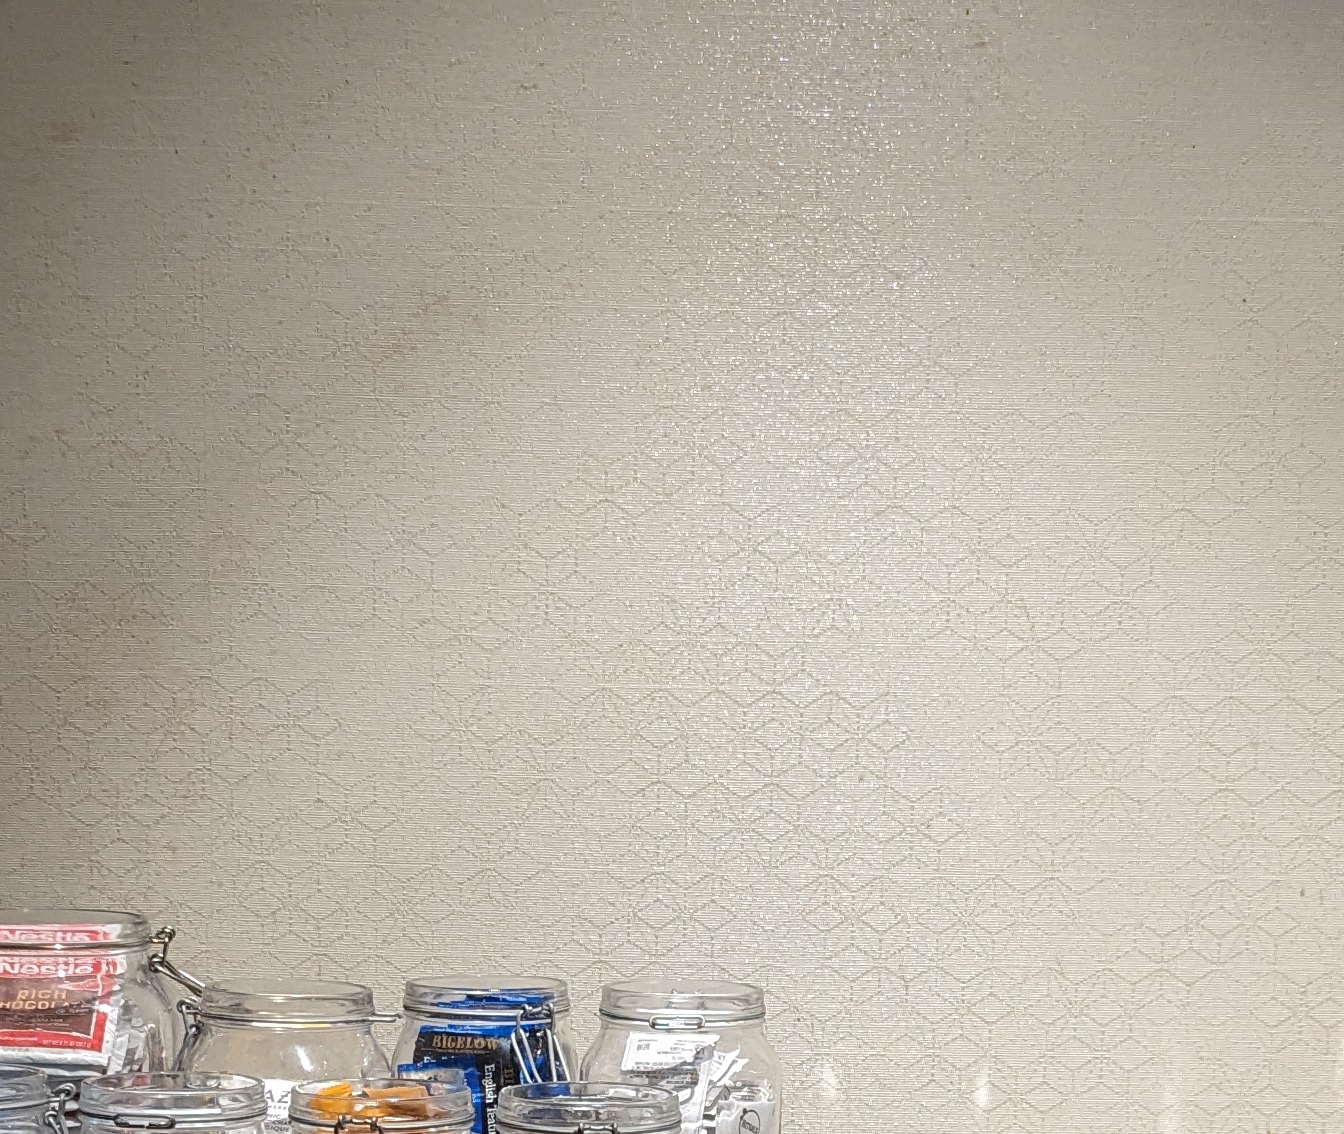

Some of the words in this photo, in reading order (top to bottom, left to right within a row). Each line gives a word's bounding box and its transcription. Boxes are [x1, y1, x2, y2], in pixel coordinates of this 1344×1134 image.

[16, 990, 67, 1000] RICH
[432, 1035, 499, 1050] BIGELOW
[482, 1064, 497, 1104] English
